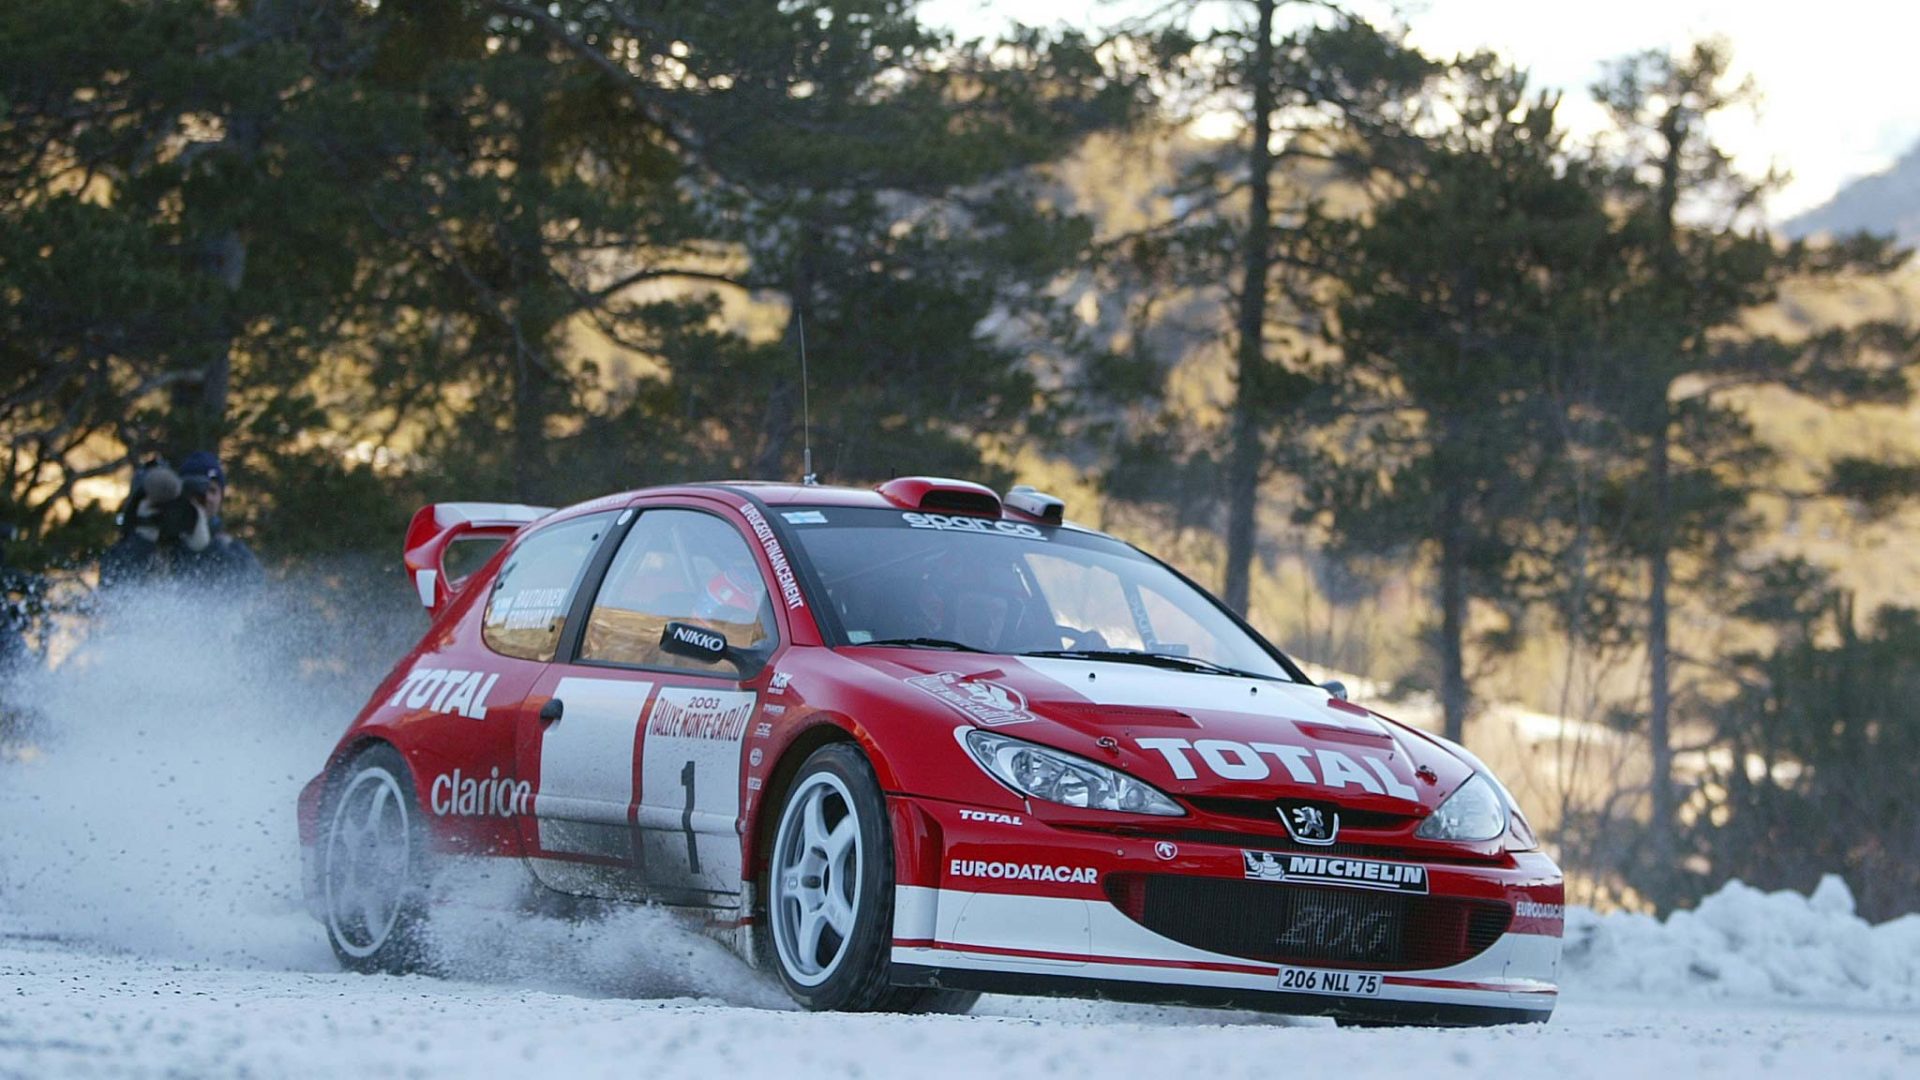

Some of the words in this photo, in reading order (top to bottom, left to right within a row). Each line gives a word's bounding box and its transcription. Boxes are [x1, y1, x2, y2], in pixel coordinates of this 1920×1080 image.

[902, 512, 1044, 538] sparco
[763, 539, 804, 610] FINANCEMENT
[673, 627, 724, 652] NIKKO
[390, 668, 500, 721] TOTAL
[688, 696, 721, 710] 2003
[649, 696, 684, 738] RALLYE
[1134, 737, 1420, 803] TOTAL
[431, 766, 532, 818] Clarion
[681, 760, 700, 874] 1
[959, 809, 1024, 826] TOTAL
[950, 859, 1099, 885] EURODATACAR
[1289, 856, 1422, 885] MICHELIN
[1282, 969, 1317, 990] 206
[1321, 973, 1351, 993] NLL
[1356, 975, 1377, 994] 75
